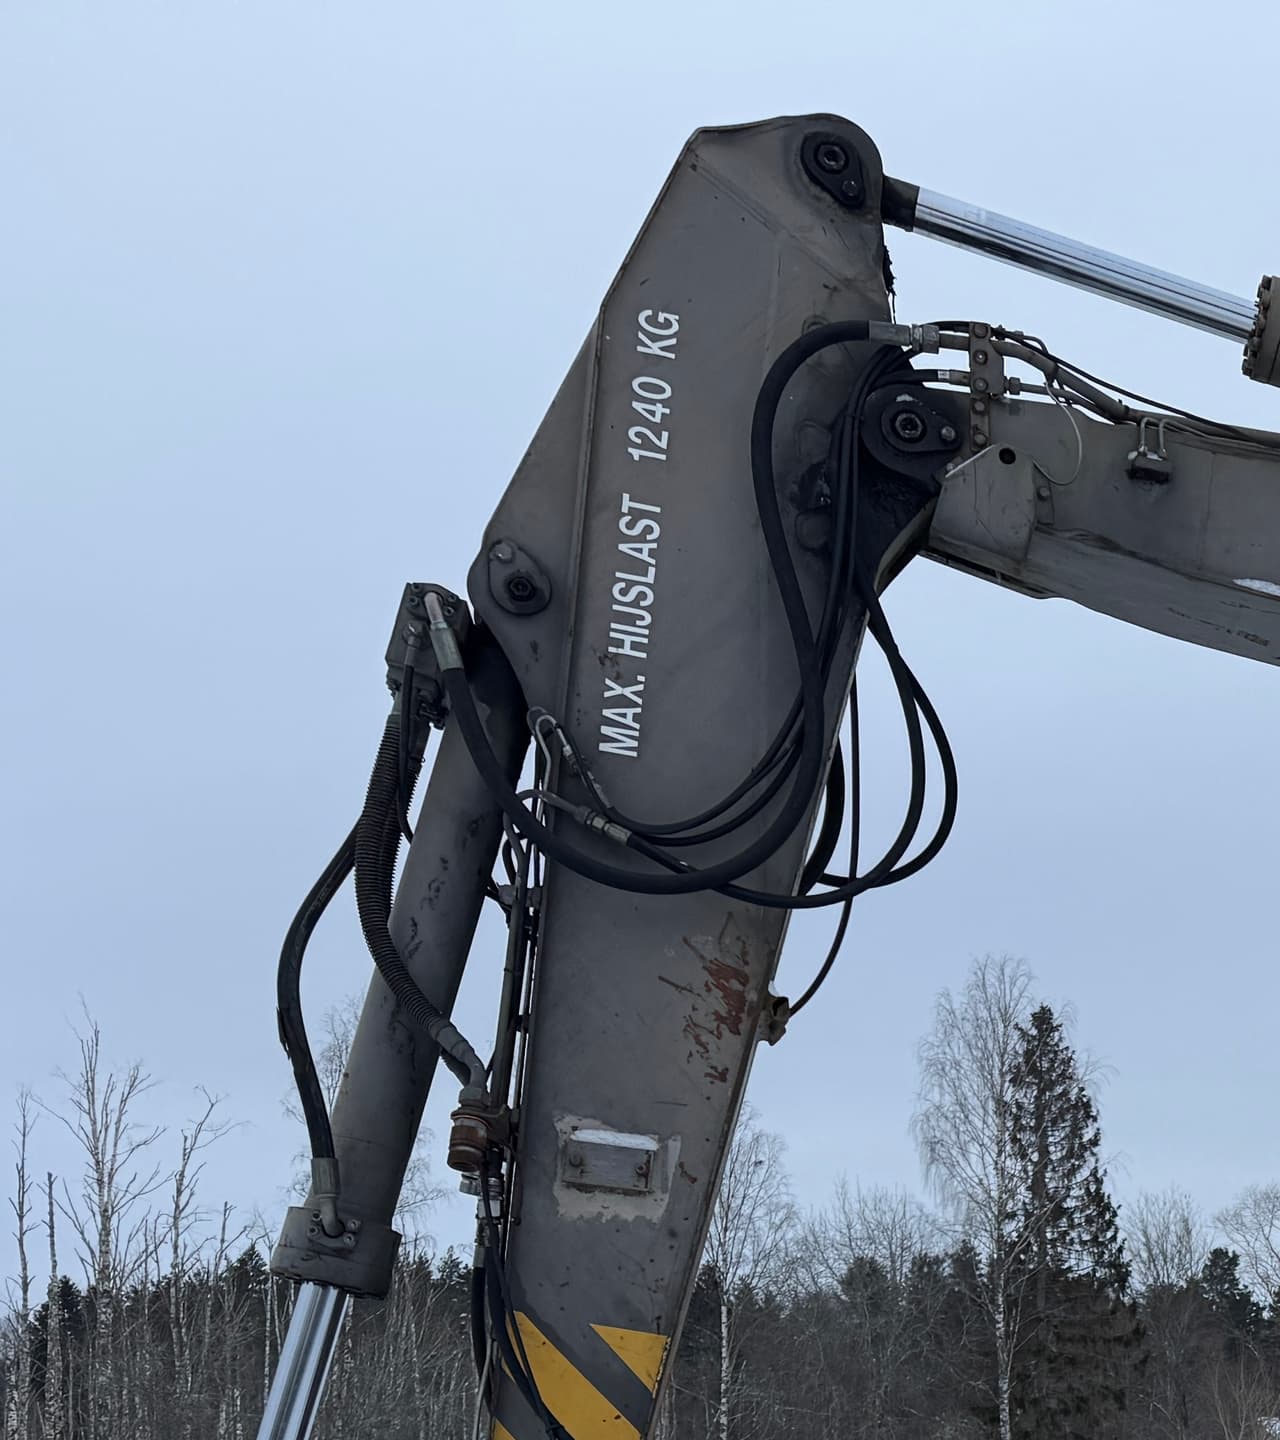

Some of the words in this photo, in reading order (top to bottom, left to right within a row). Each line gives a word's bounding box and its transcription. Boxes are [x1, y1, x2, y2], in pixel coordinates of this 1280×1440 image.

[636, 309, 681, 360] KG
[627, 375, 673, 462] 1240
[607, 492, 662, 659] HIJSLAST
[598, 673, 646, 758] MAX.
